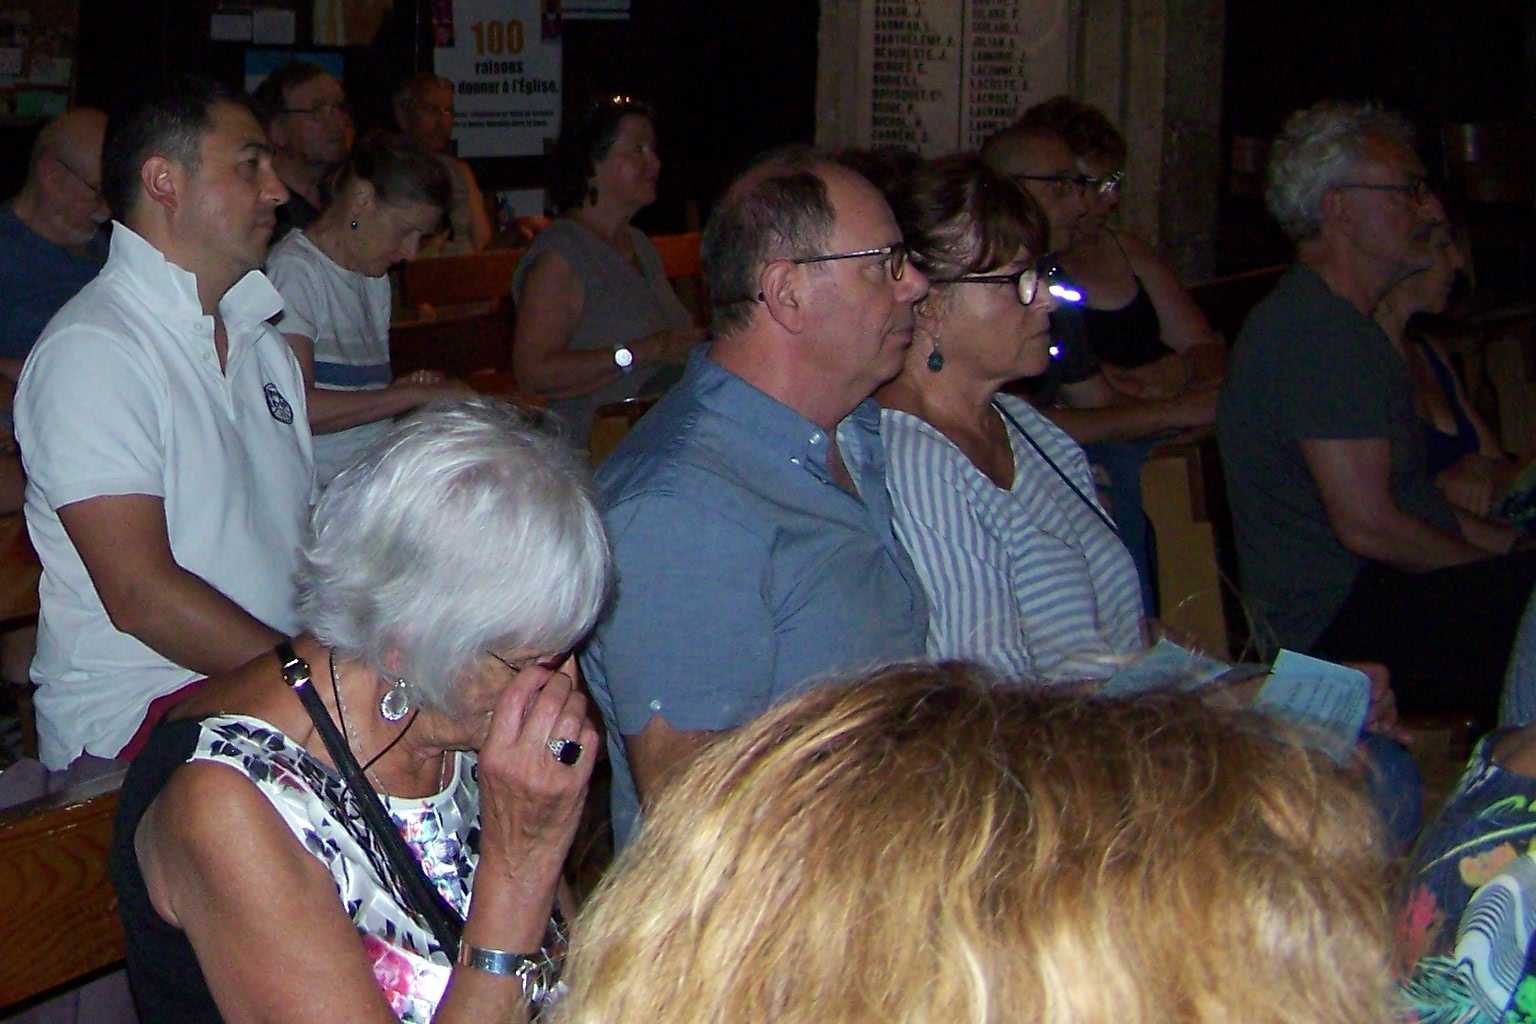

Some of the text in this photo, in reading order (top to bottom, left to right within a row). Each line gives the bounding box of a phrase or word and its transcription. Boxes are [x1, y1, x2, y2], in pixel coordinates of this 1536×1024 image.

[470, 19, 525, 55] 100
[475, 59, 524, 75] raisons
[458, 80, 501, 94] donner
[502, 79, 509, 93] à
[512, 78, 559, 95] l'Église.
